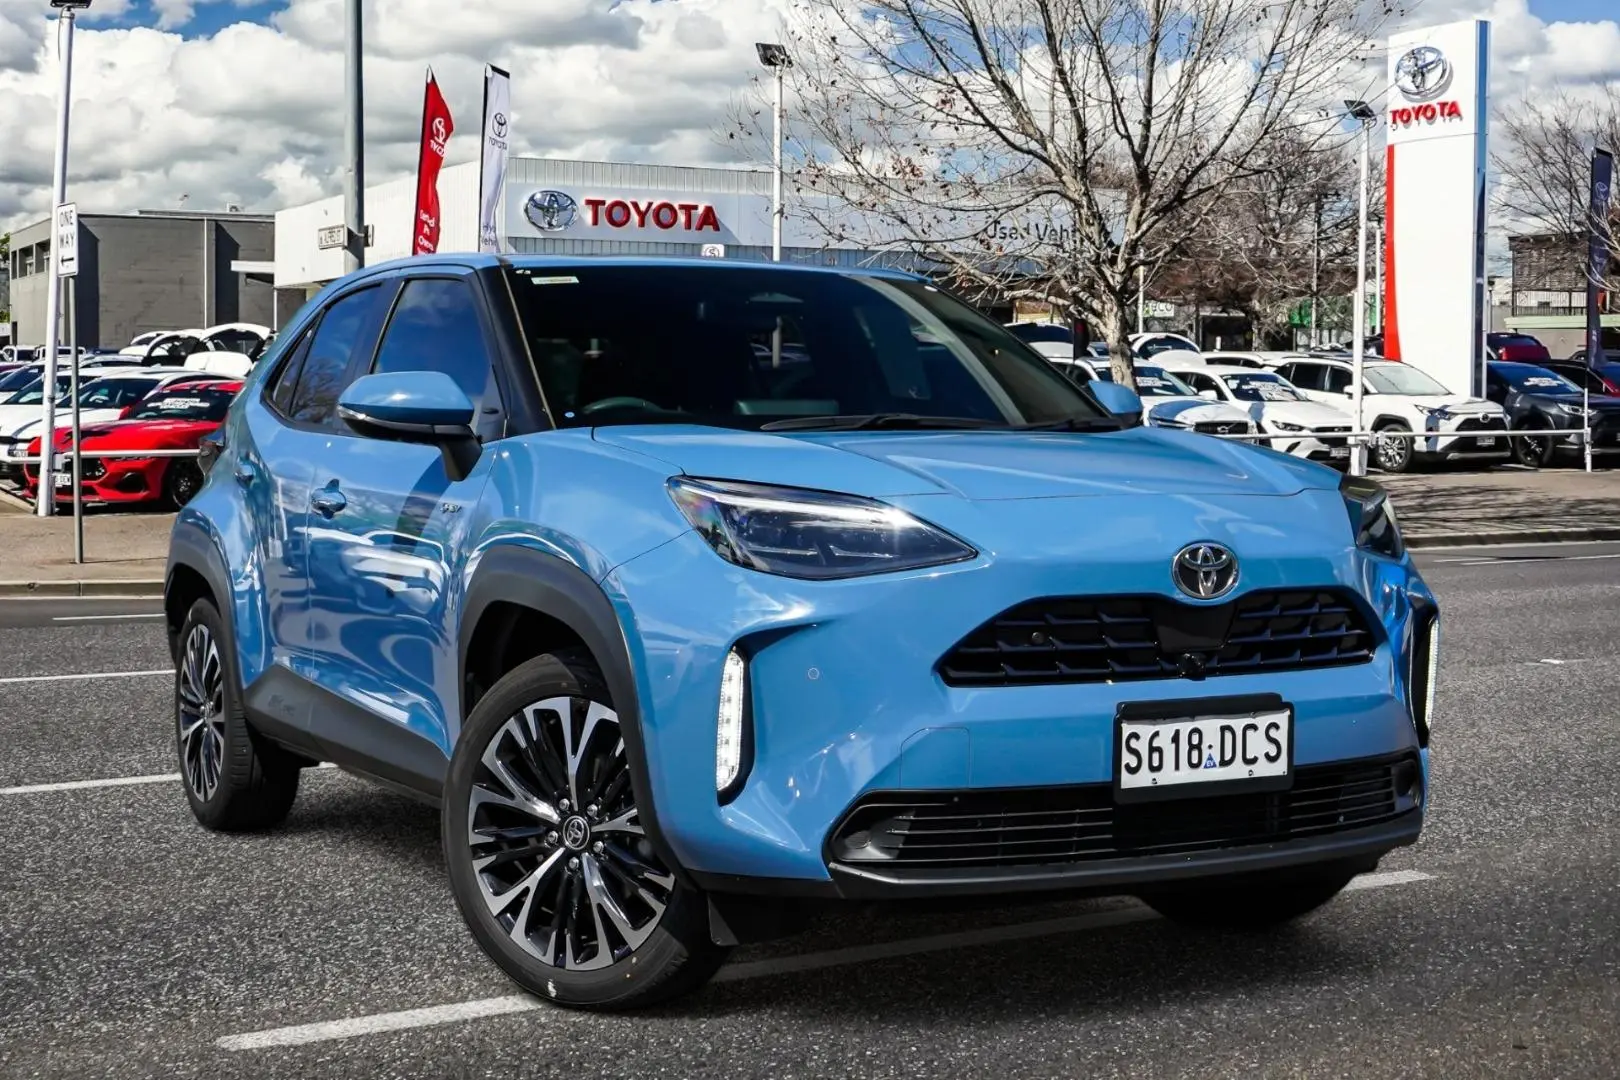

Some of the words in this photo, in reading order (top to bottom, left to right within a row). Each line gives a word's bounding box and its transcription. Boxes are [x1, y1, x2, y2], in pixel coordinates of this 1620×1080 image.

[1389, 101, 1461, 124] TOYOTA
[59, 209, 74, 227] ONE
[584, 198, 721, 232] TOYOTA
[59, 231, 76, 249] WAY
